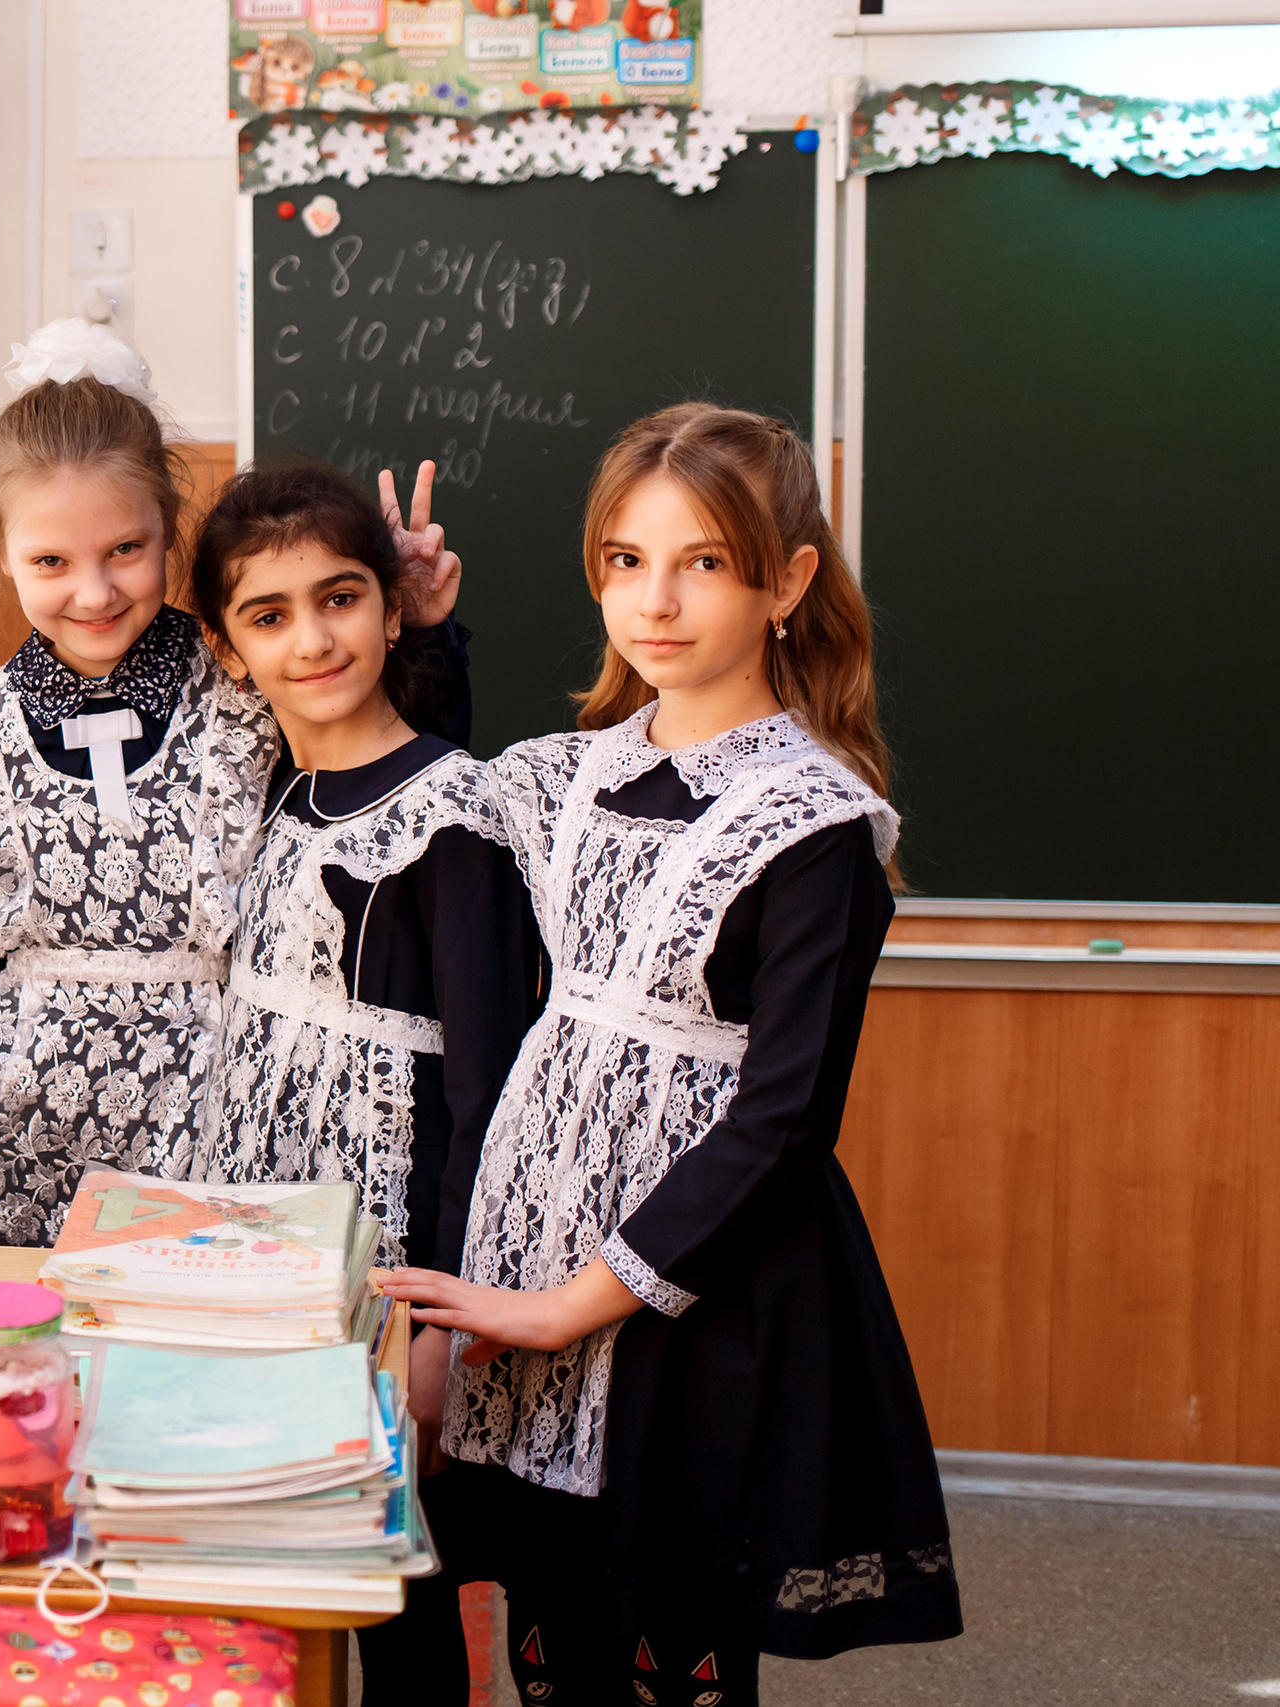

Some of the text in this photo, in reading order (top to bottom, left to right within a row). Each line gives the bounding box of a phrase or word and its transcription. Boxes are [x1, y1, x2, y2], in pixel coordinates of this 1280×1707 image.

[328, 234, 364, 298] 8
[335, 316, 388, 362] 10
[452, 321, 493, 370] 2
[337, 380, 382, 427] 11
[92, 1186, 184, 1233] 4
[128, 1243, 245, 1260] язык
[169, 1258, 322, 1271] Русский
